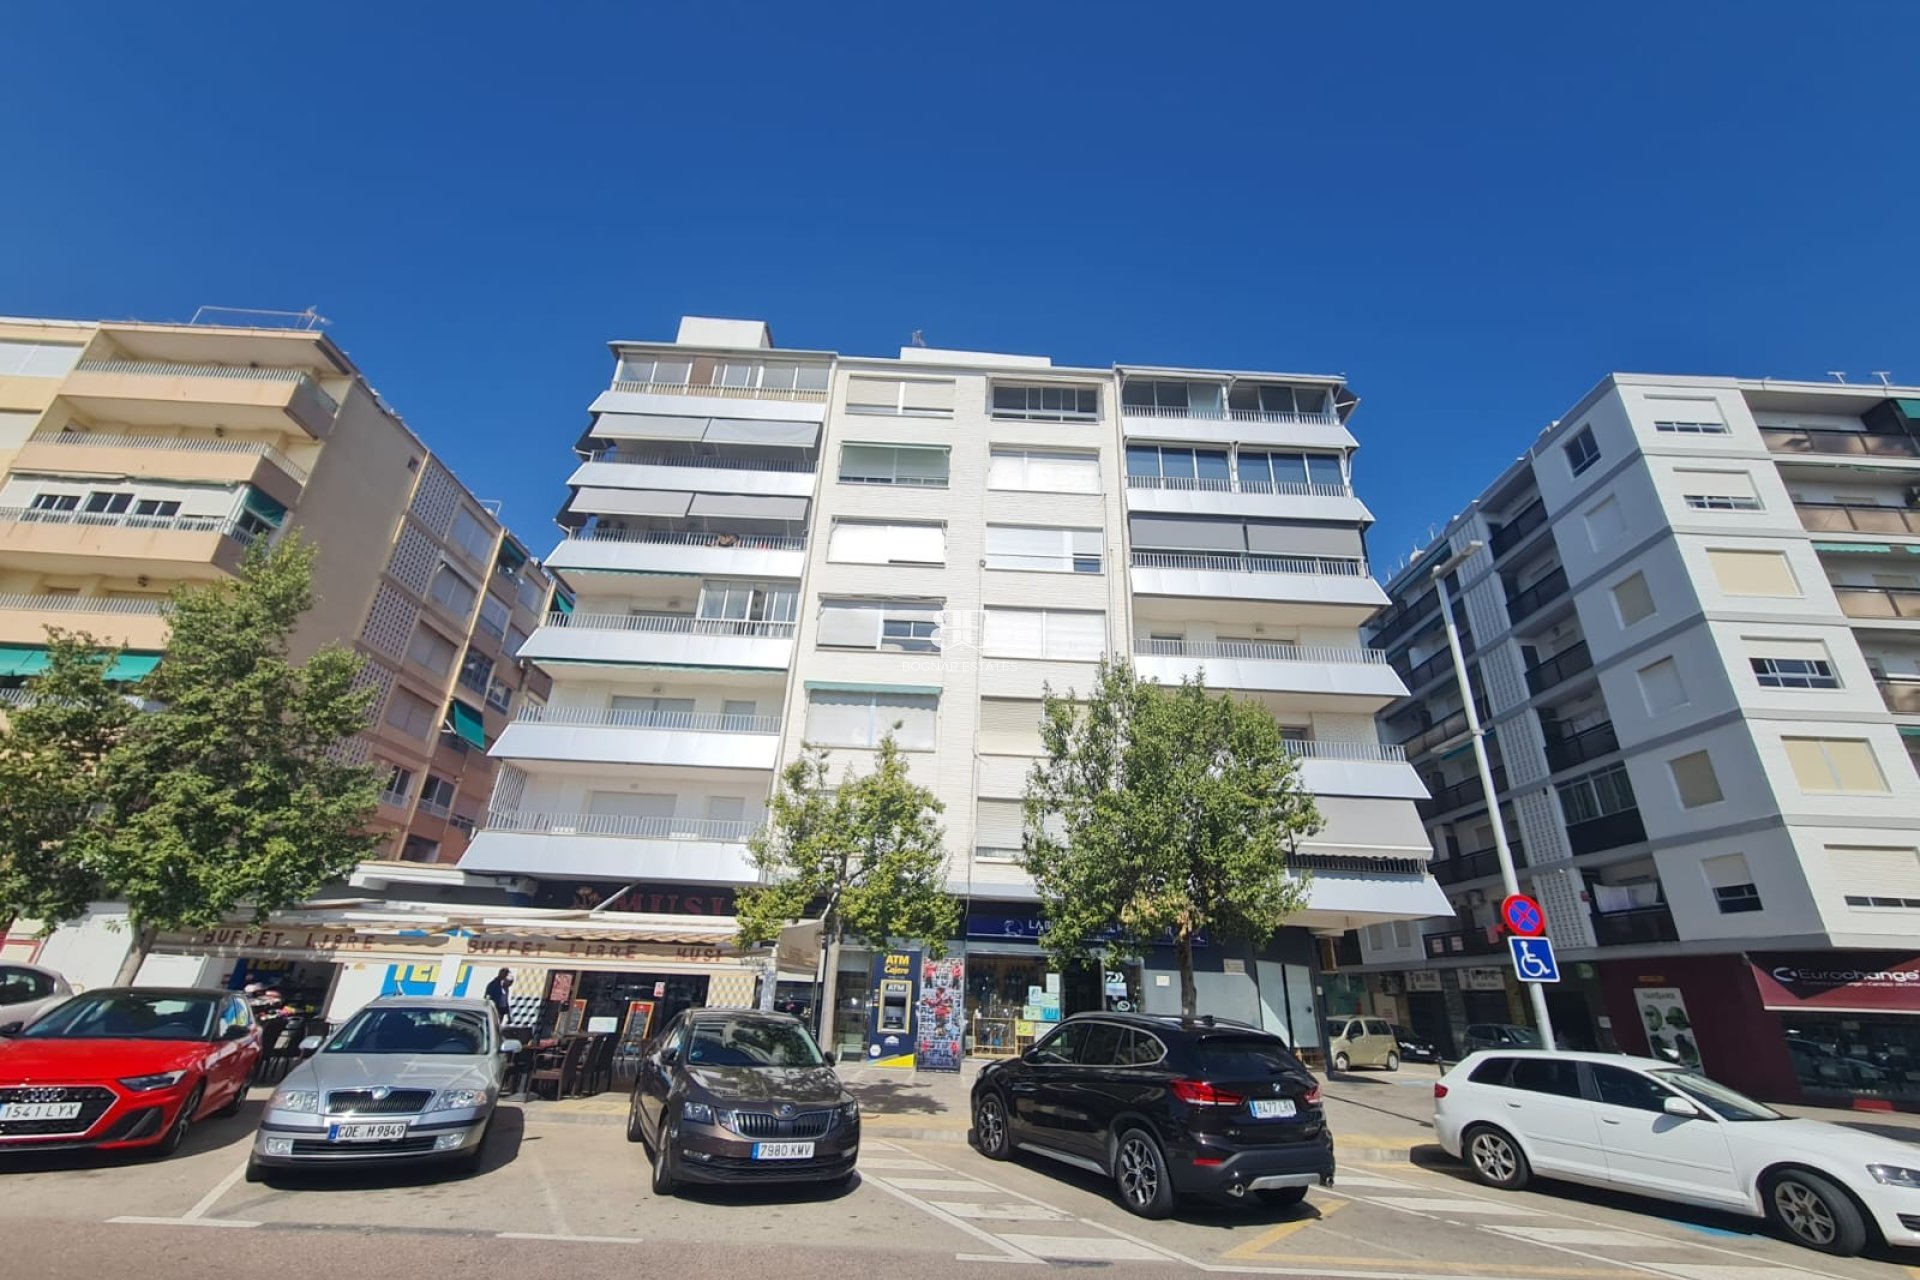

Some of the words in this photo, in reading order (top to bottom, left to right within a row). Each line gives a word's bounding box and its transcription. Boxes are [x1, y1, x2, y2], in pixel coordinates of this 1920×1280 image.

[203, 928, 286, 946] BUFFET
[305, 932, 376, 949] LIBRE
[467, 940, 550, 956] BUFFET
[568, 943, 638, 959] LIBRE
[885, 955, 910, 966] ATM
[884, 965, 910, 975] Cajero
[760, 1144, 788, 1156] 7980
